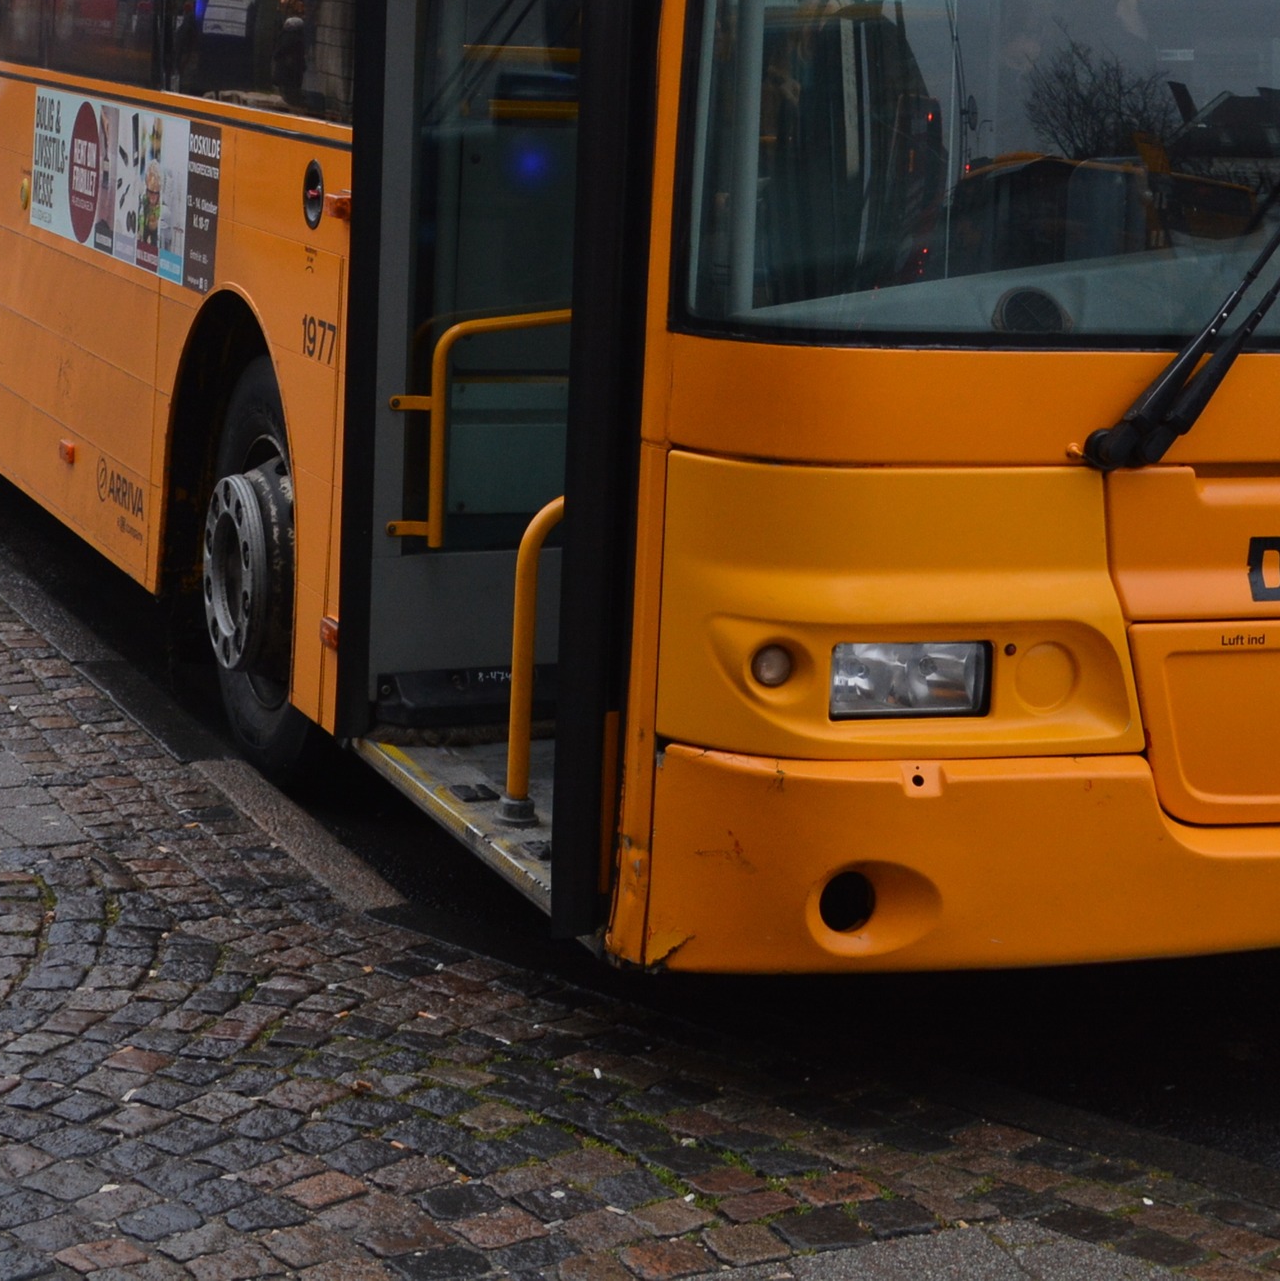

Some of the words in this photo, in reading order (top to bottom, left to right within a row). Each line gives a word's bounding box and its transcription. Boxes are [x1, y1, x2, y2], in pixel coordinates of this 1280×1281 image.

[36, 95, 55, 131] BOLIG
[54, 100, 62, 134] &
[189, 132, 221, 159] ROSKILDE
[32, 171, 54, 209] MESSE
[302, 313, 337, 366] 1977
[108, 469, 145, 522] ARRIVA
[1221, 634, 1245, 646] Luft
[1247, 634, 1266, 645] ind
